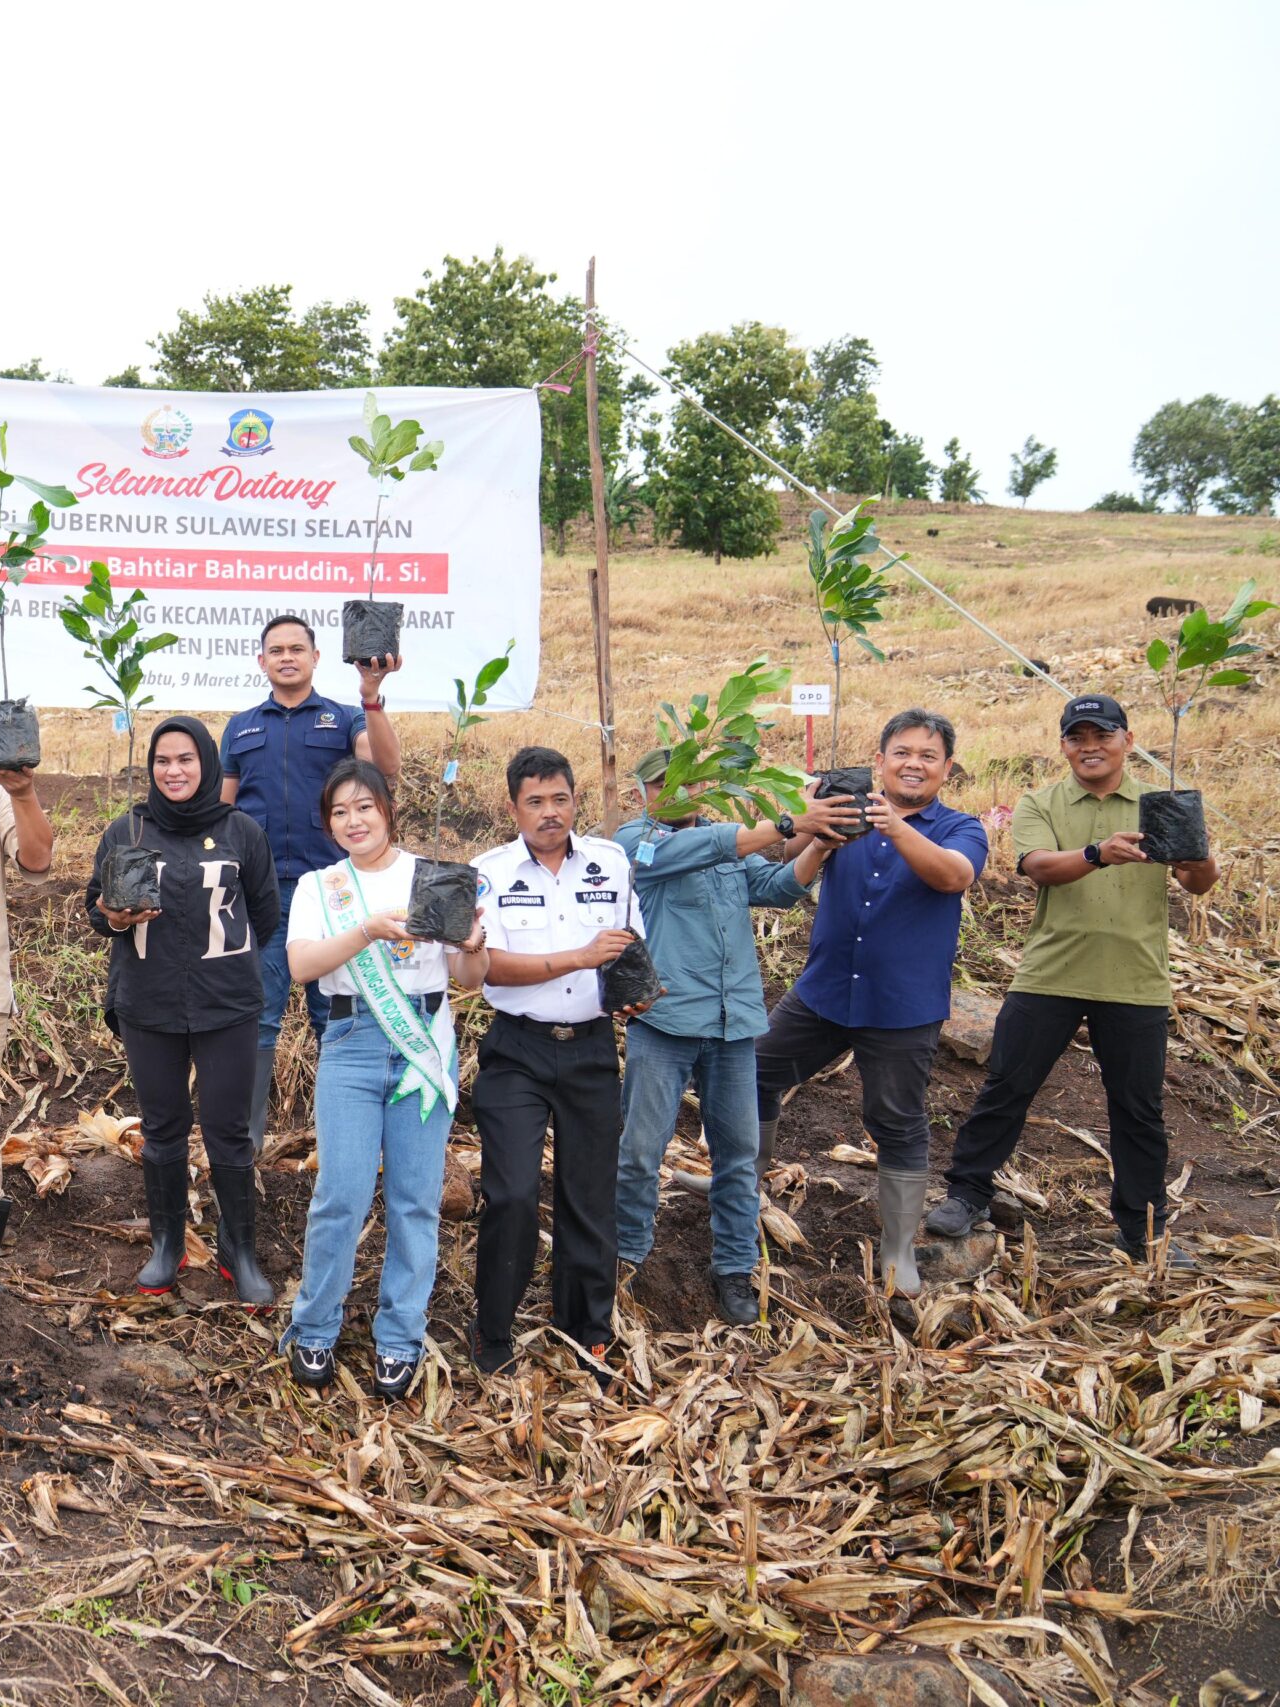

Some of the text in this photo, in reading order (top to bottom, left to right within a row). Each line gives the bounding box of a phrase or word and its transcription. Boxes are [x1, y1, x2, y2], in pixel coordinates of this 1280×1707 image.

[74, 462, 337, 510] Selamat Datang
[50, 512, 168, 534] UBERNUR
[176, 515, 296, 537] SULAWESI
[305, 518, 413, 538] SELATAN
[108, 555, 197, 578] Bahtiar
[205, 559, 355, 584] Baharuddin,
[363, 562, 391, 582] M.
[399, 562, 427, 582] Si.
[162, 605, 279, 626] KECAMATAN
[140, 671, 271, 688] abtu, 9 Maret 202
[354, 948, 390, 1000] NGKUNGAN
[379, 997, 414, 1043] INDONESIA
[407, 1035, 432, 1054] 2023
